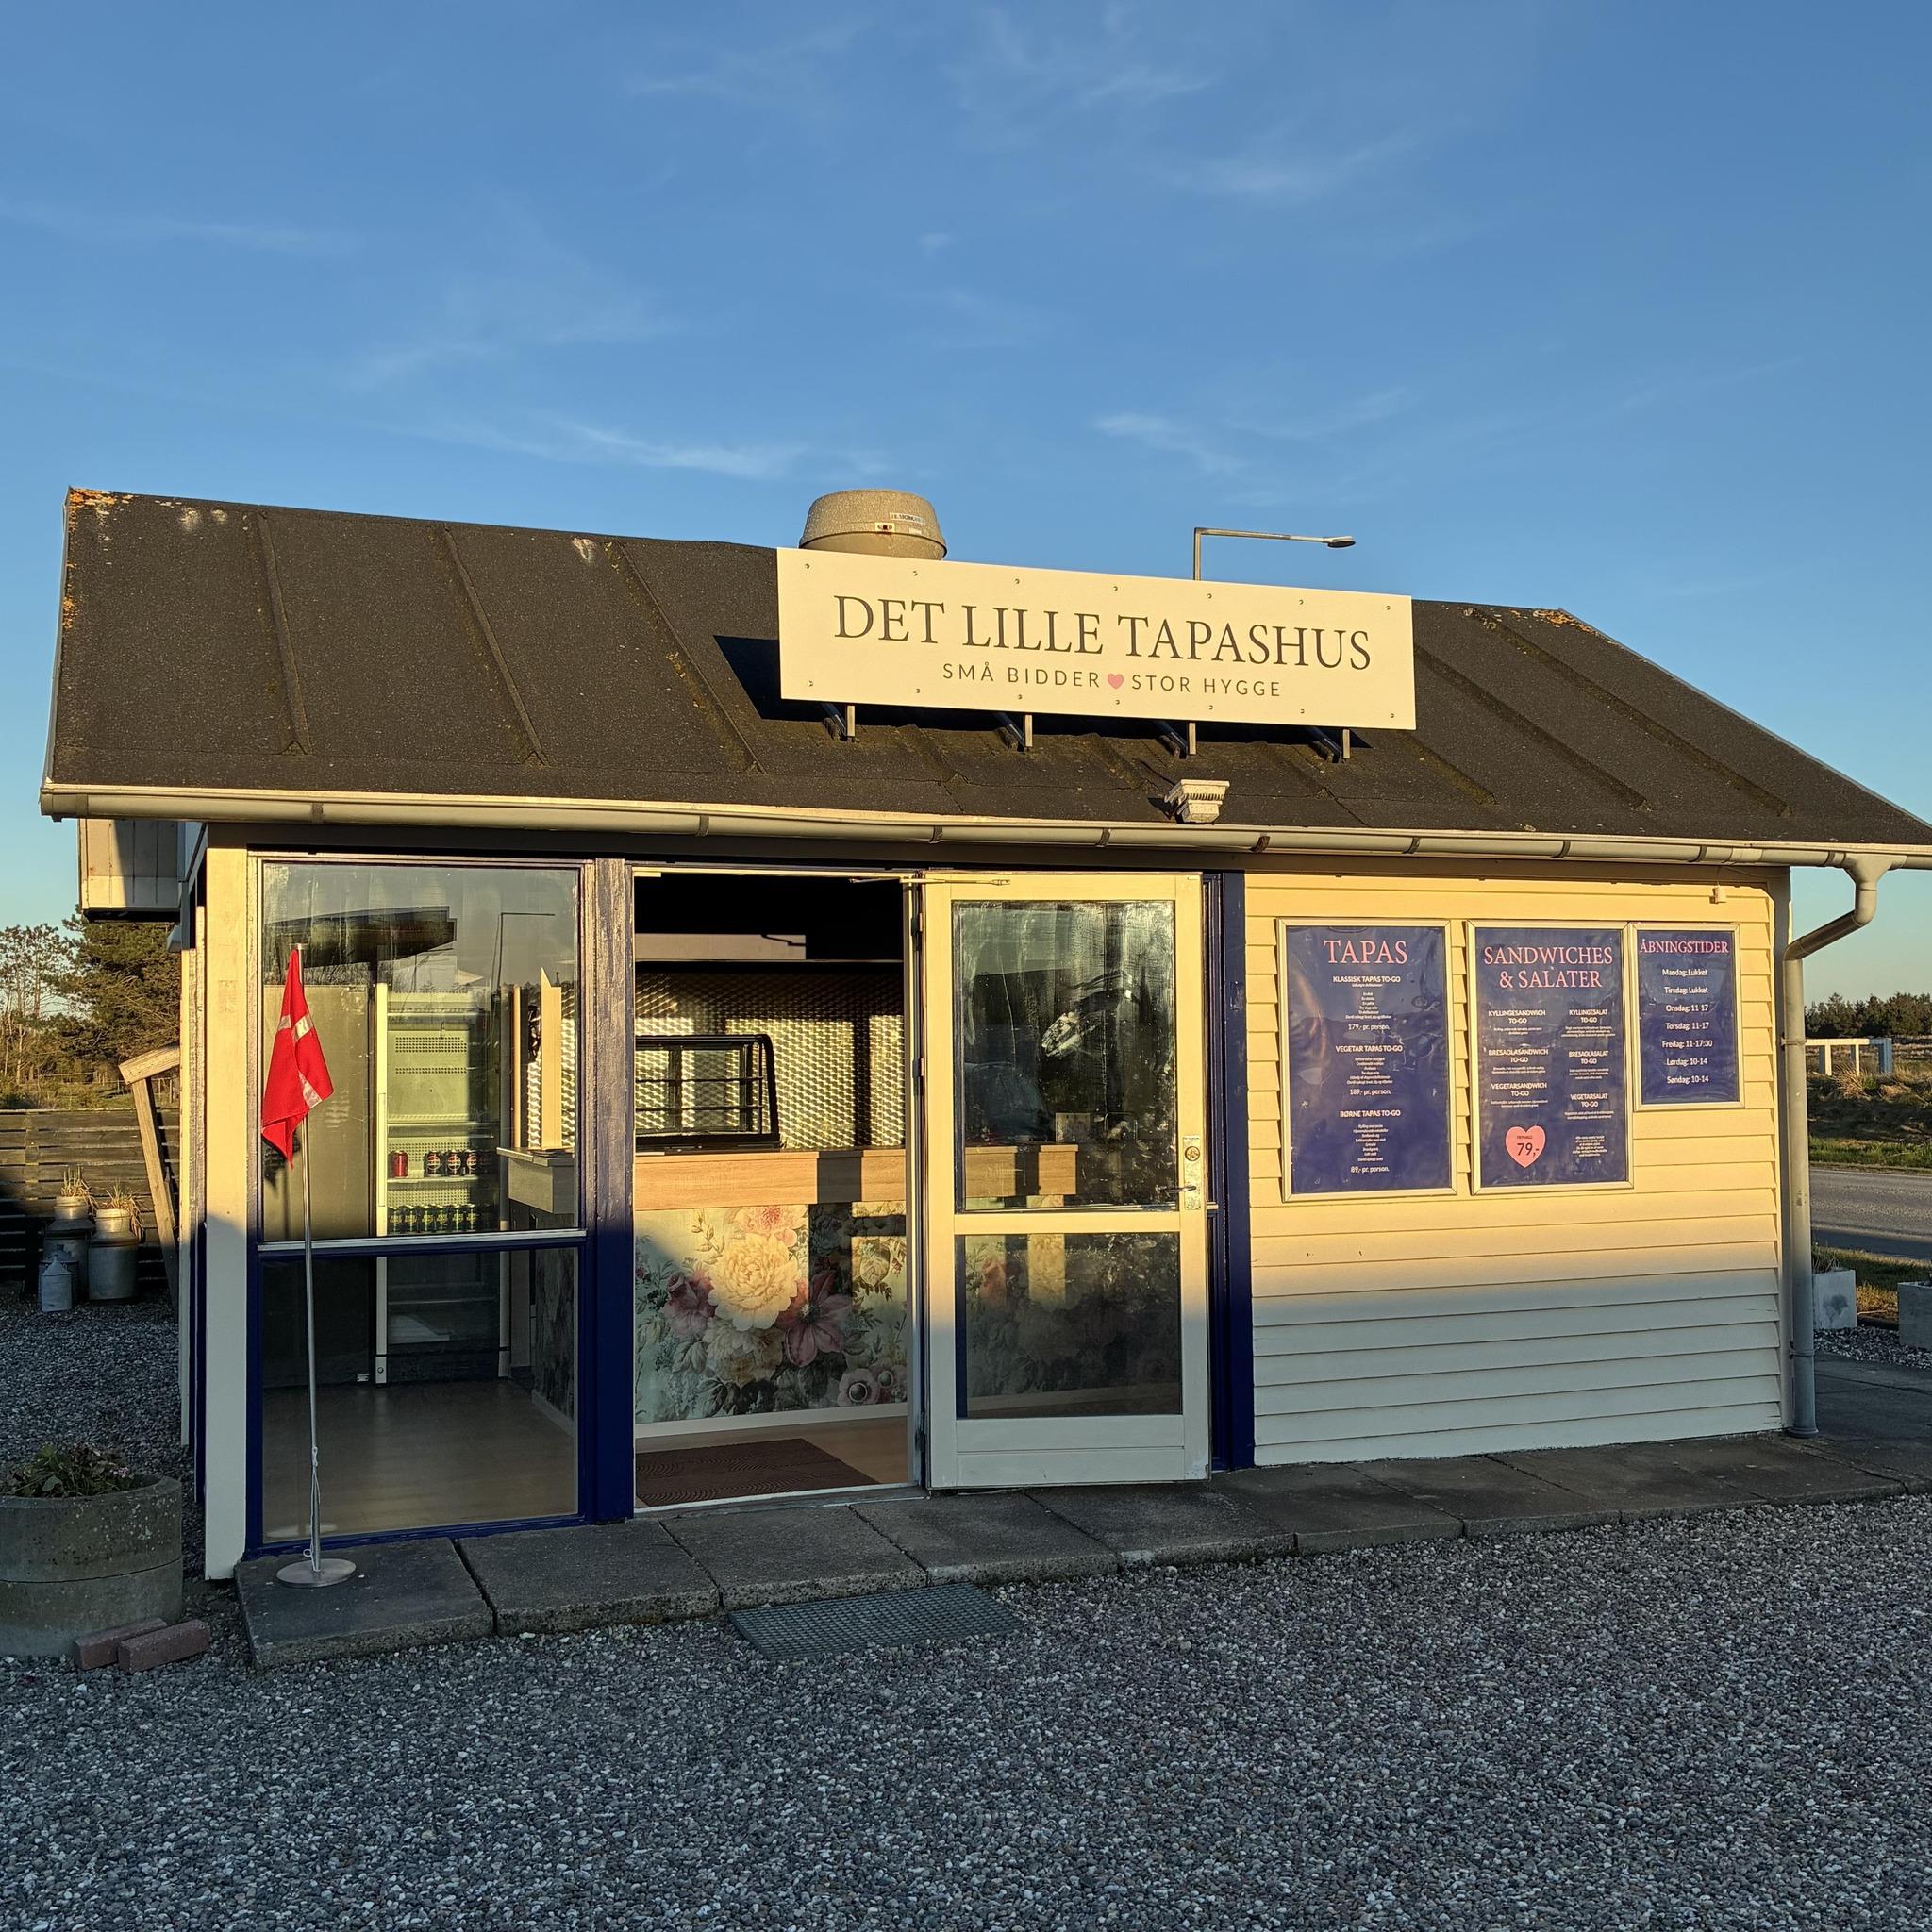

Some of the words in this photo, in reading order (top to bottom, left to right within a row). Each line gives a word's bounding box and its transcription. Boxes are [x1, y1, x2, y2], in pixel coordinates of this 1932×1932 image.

[834, 595, 945, 644] DET
[961, 605, 1104, 655] LILLE
[1117, 614, 1371, 670] TAPASHUS
[942, 661, 994, 681] SMÅ
[1008, 667, 1100, 688] BIDDER
[1132, 675, 1191, 692] STOR
[1204, 678, 1281, 696] HYGGE
[1640, 939, 1729, 953] ÅBNINGSTIDER
[1324, 940, 1408, 965] TAPAS
[1484, 947, 1612, 965] SANDWICHES
[1662, 968, 1688, 977] Mandag:
[1688, 968, 1708, 976] Lukket
[1499, 972, 1513, 989] &
[1517, 970, 1603, 989] SALATER
[1664, 986, 1689, 995] Tirsdag:
[1689, 986, 1708, 994] Lukket
[1665, 1004, 1690, 1013] Onsdag:
[1666, 1022, 1690, 1031] Torsdag:
[1662, 1040, 1685, 1049] Fredag:
[1666, 1058, 1690, 1067] Lørdag:
[1690, 1058, 1707, 1066] 10-14
[1667, 1075, 1690, 1085] Søndag:
[1691, 1075, 1708, 1084] 10-14
[1516, 1142, 1540, 1158] 79,-
